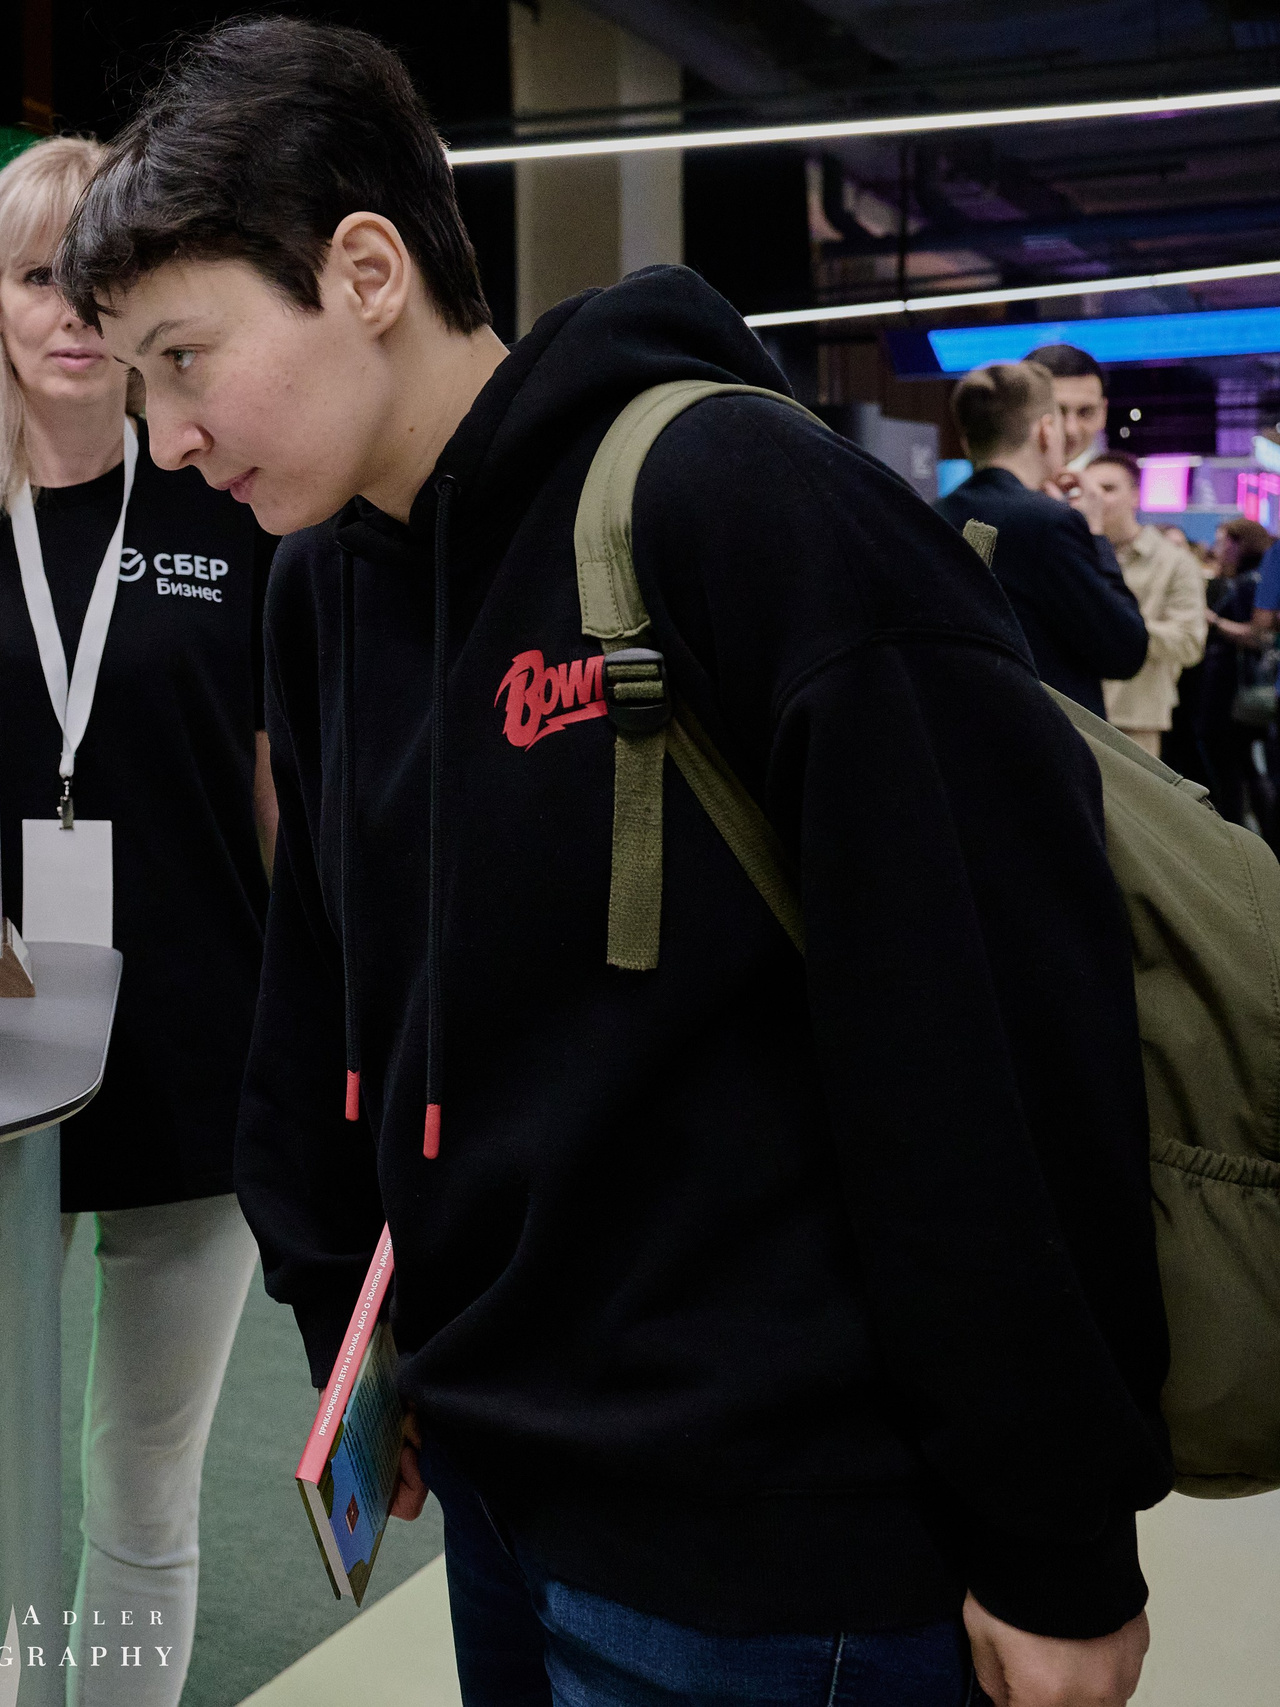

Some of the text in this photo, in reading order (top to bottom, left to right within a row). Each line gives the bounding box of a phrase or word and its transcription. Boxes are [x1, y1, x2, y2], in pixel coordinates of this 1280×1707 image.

[153, 552, 228, 581] СБЕР
[156, 577, 222, 603] Бизнес
[318, 1384, 342, 1436] ПРИКЛЮЧЕНИЯ
[338, 1364, 349, 1382] ПЕТИ
[357, 1310, 368, 1329] ДЕЛО
[367, 1269, 383, 1301] ЗОЛОТОМ
[380, 1237, 392, 1267] ДРАКОН
